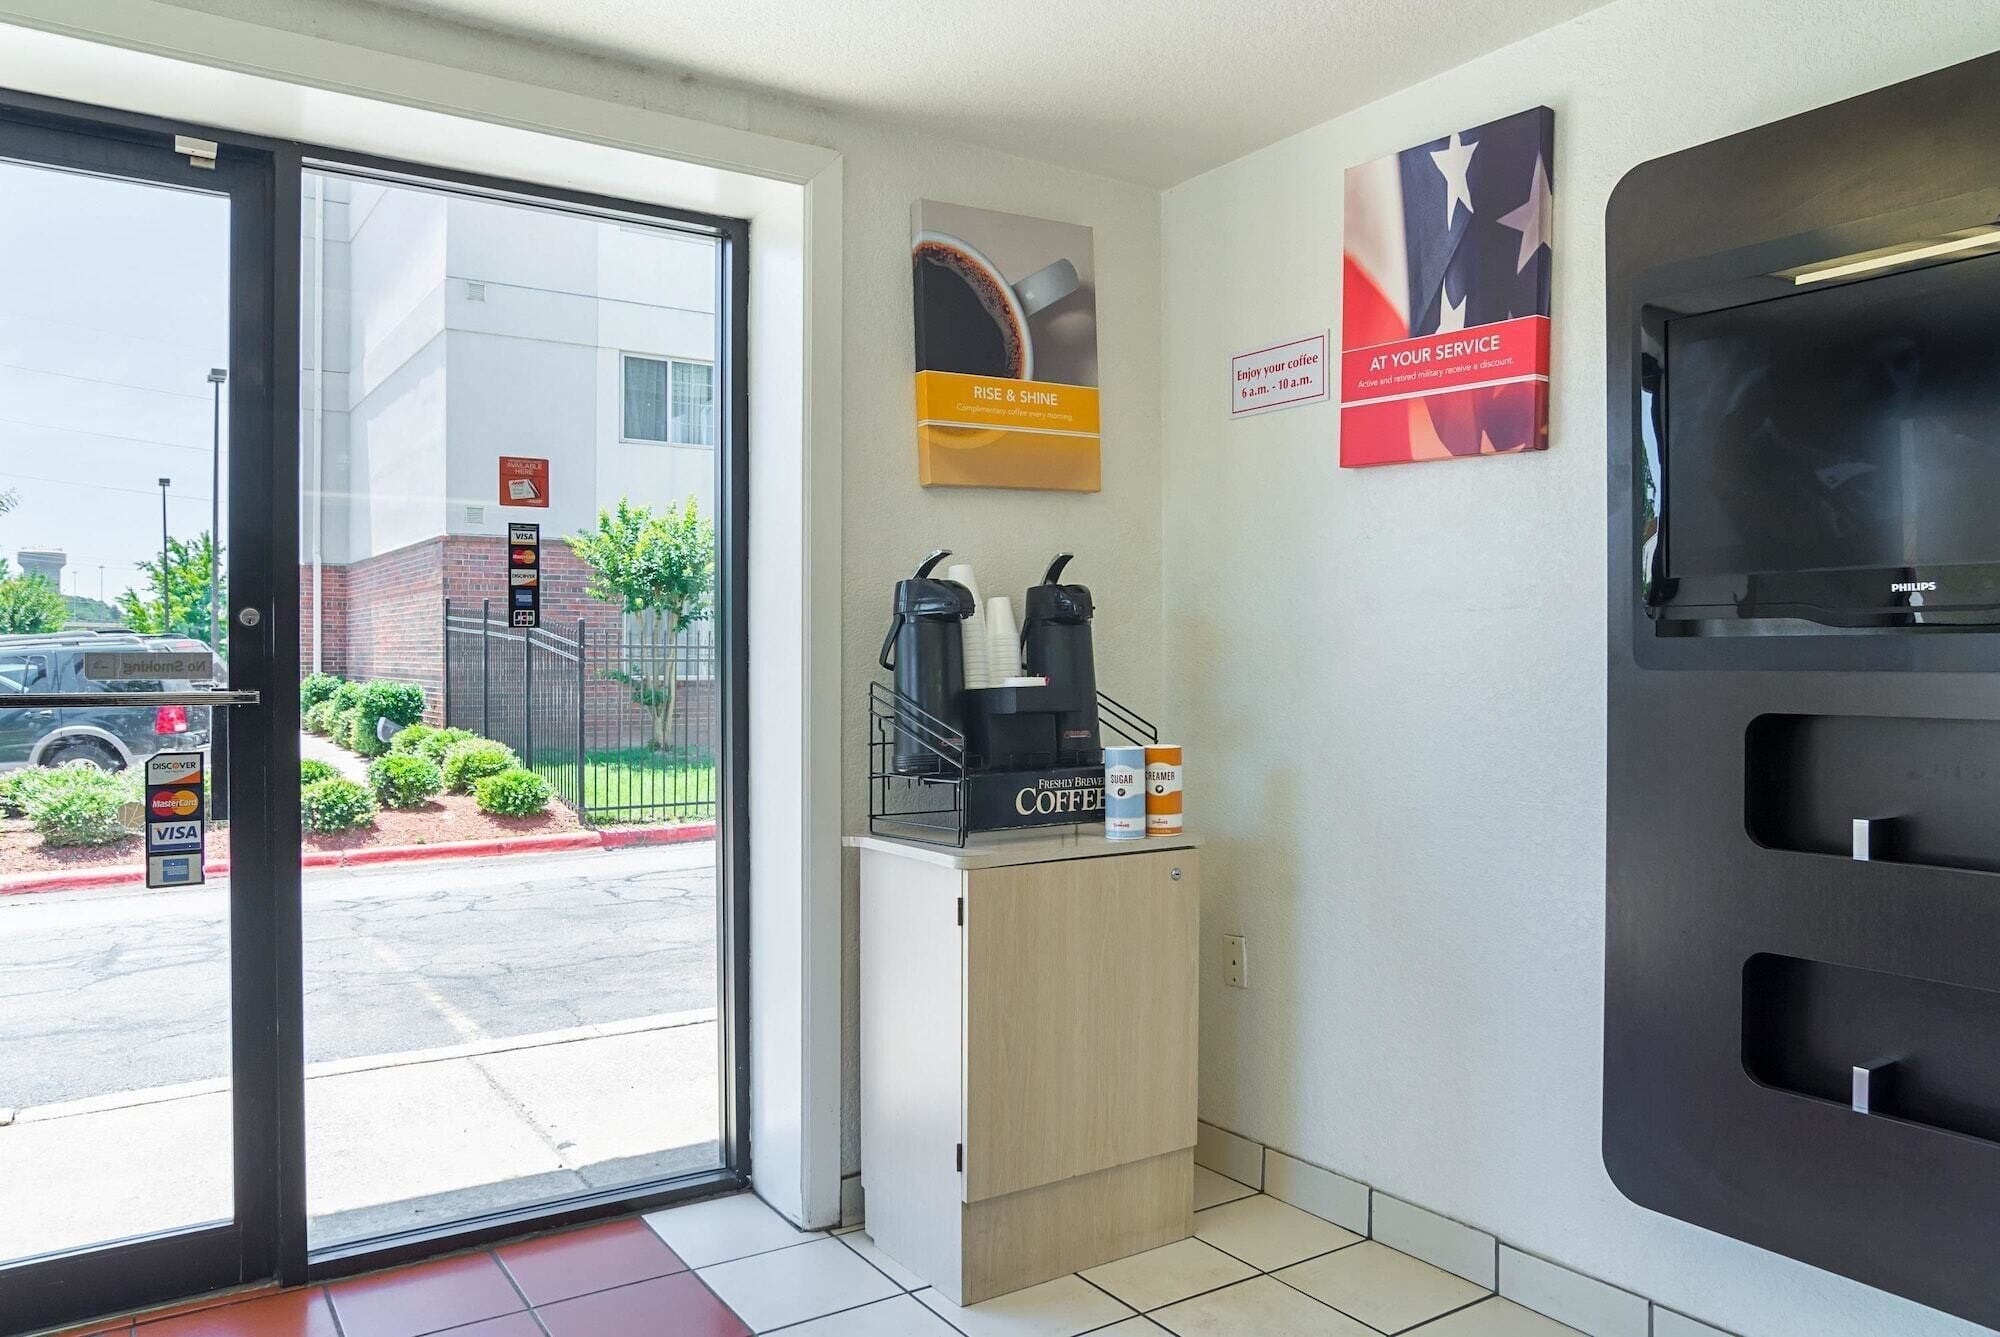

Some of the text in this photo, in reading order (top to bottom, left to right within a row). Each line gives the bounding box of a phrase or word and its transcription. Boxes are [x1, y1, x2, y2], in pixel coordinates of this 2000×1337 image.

[1370, 335, 1500, 371] AT YOUR SERVICE
[1237, 353, 1319, 382] Enjoy your coffee
[1358, 379, 1378, 389] Active
[1379, 375, 1393, 385] and
[1394, 371, 1417, 383] retired
[1417, 367, 1444, 378] military
[1445, 363, 1472, 375] receive
[1479, 356, 1514, 369] discount.
[1241, 387, 1247, 398] 6
[1249, 385, 1270, 397] a.m.
[1278, 378, 1289, 390] 10
[1290, 375, 1313, 388] a.m.
[973, 385, 1058, 406] RISE & SHINE
[956, 402, 1007, 416] Complimentary
[1008, 406, 1028, 417] coffee
[1029, 410, 1046, 419] every
[506, 462, 543, 470] AVAILABLE
[515, 532, 534, 540] VISA
[1891, 581, 1937, 592] PHILIPS
[152, 761, 197, 770] DISCOVER
[1039, 776, 1105, 790] FRESHLY BREWE
[1110, 774, 1134, 784] SUGAR
[152, 799, 199, 809] MasterCard
[157, 825, 198, 841] VISA
